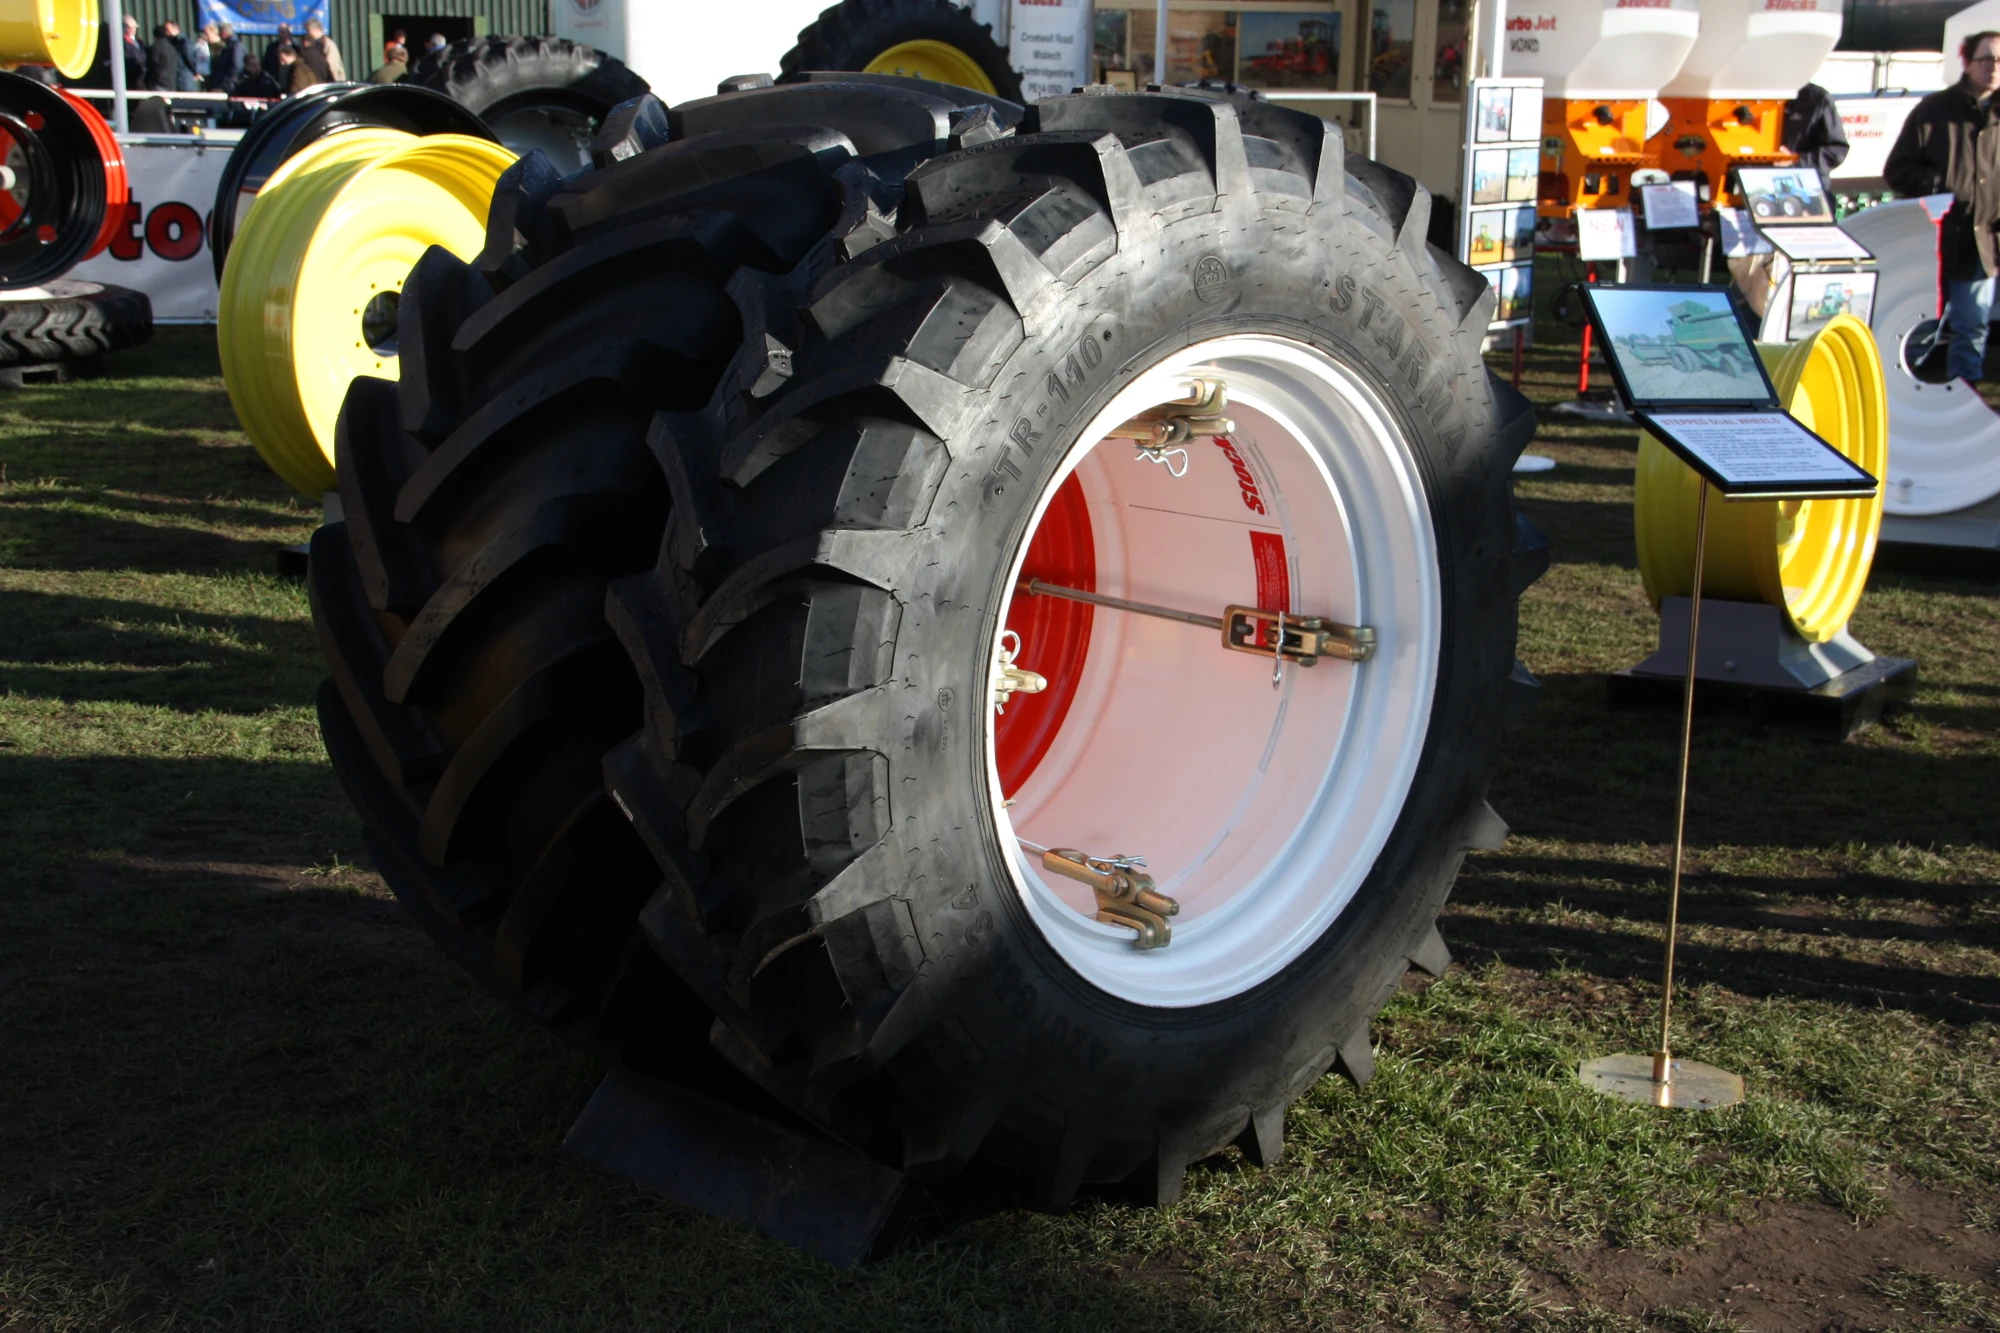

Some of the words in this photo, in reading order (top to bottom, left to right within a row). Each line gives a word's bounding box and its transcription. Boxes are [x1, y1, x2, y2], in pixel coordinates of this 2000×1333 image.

[1056, 34, 1074, 44] Road
[1506, 15, 1532, 31] urbo
[1534, 15, 1557, 31] Jet
[992, 332, 1102, 482] TR-110
[1211, 433, 1266, 516] Stock
